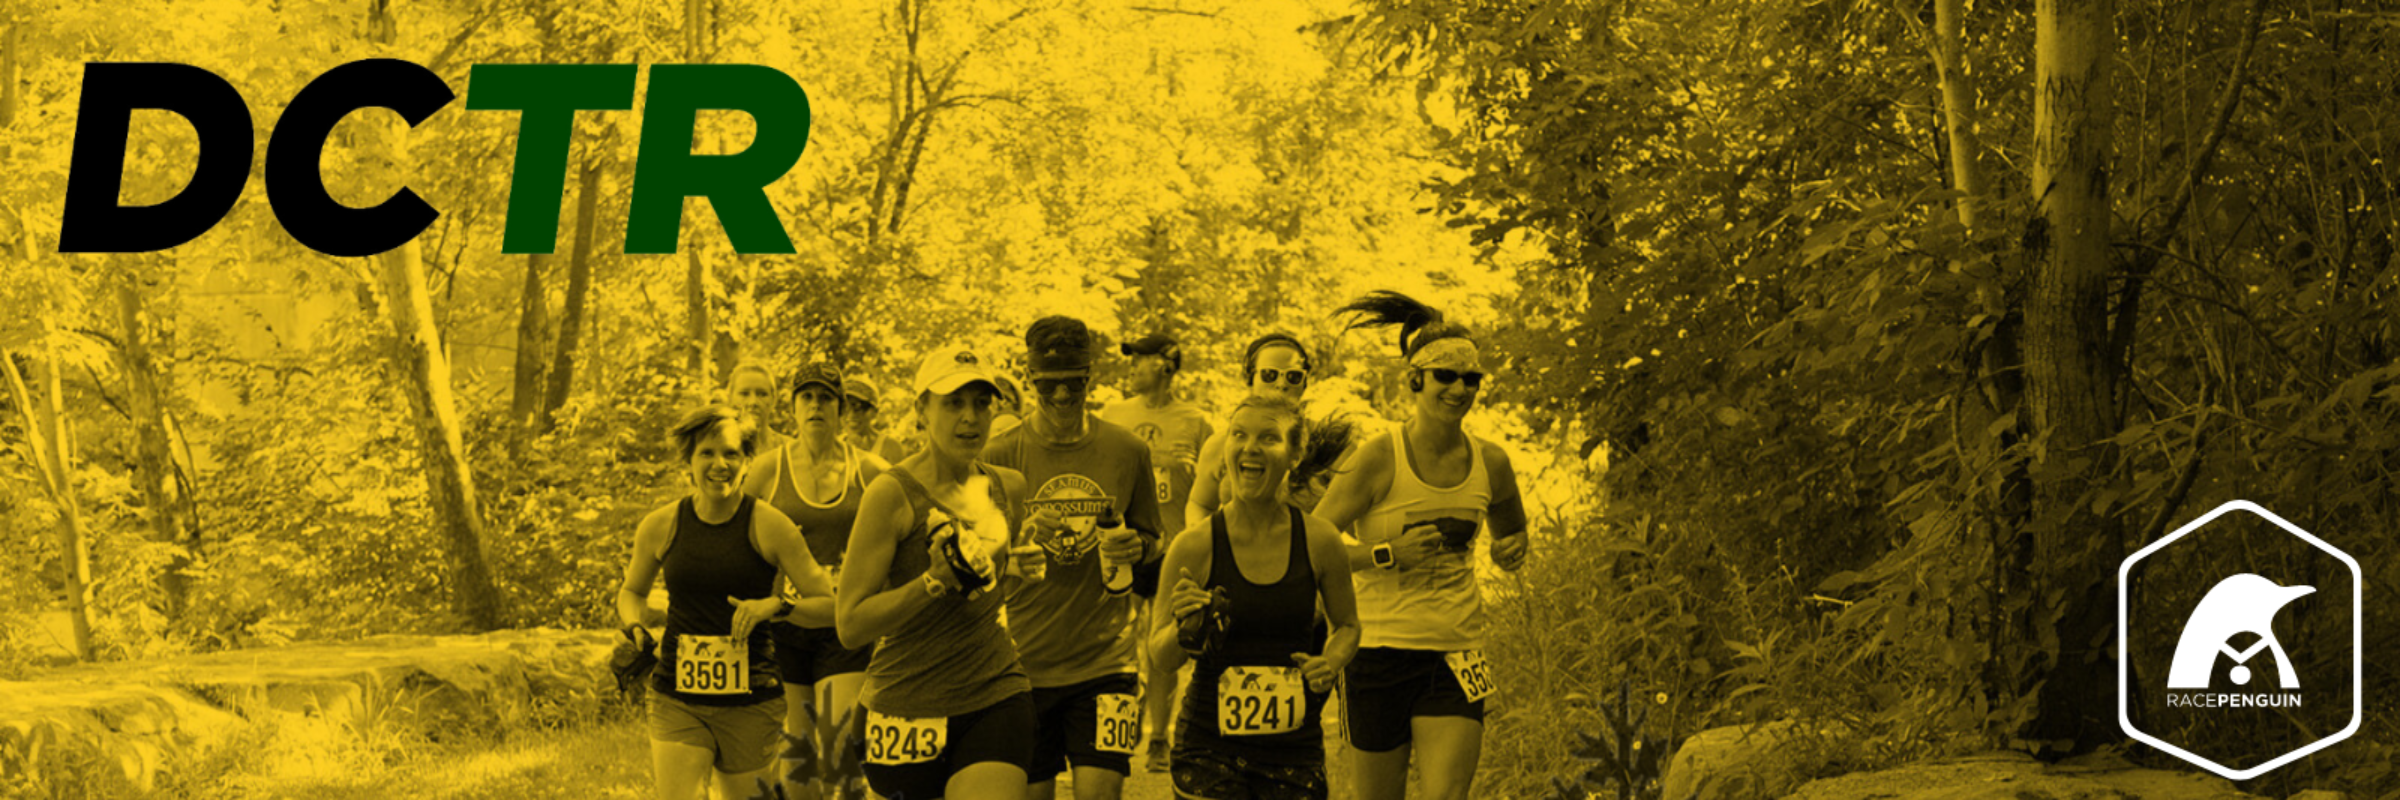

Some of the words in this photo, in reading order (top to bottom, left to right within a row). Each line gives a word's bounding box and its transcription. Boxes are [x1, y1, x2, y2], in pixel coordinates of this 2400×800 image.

[682, 660, 741, 690] 3591
[1226, 695, 1295, 730] 3241
[870, 725, 938, 760] 3243
